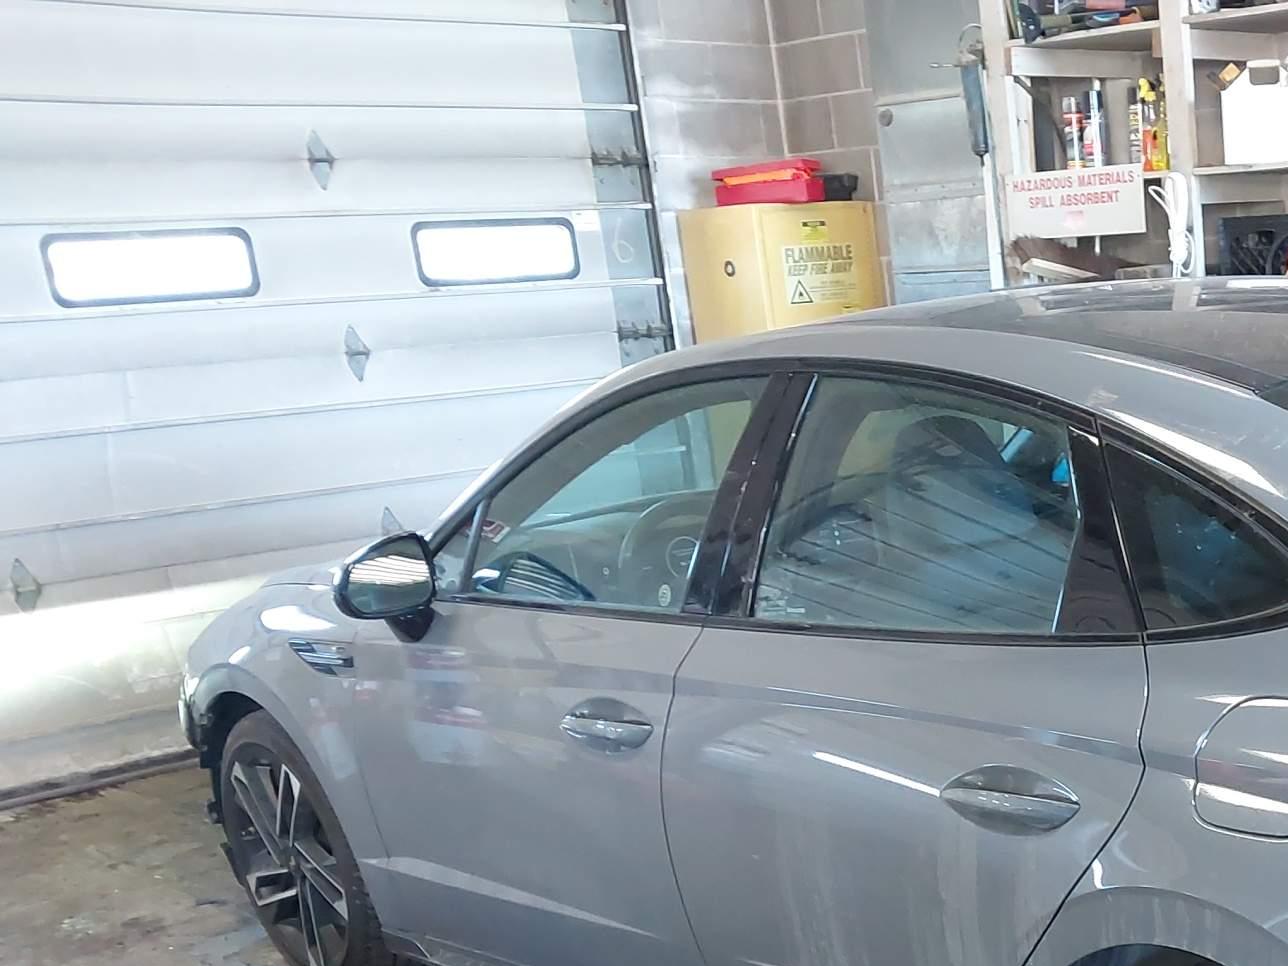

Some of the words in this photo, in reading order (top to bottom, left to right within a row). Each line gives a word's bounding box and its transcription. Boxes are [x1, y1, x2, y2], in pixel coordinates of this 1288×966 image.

[1012, 176, 1073, 192] HAZARDOUS
[1077, 170, 1135, 187] MATERIALS
[1029, 194, 1055, 209] SPILL
[1060, 190, 1120, 207] ABSORBENT
[784, 244, 853, 264] FLAMMABLE
[788, 264, 808, 276] KEEP
[810, 262, 828, 275] FIRE
[831, 261, 853, 274] AWAY
